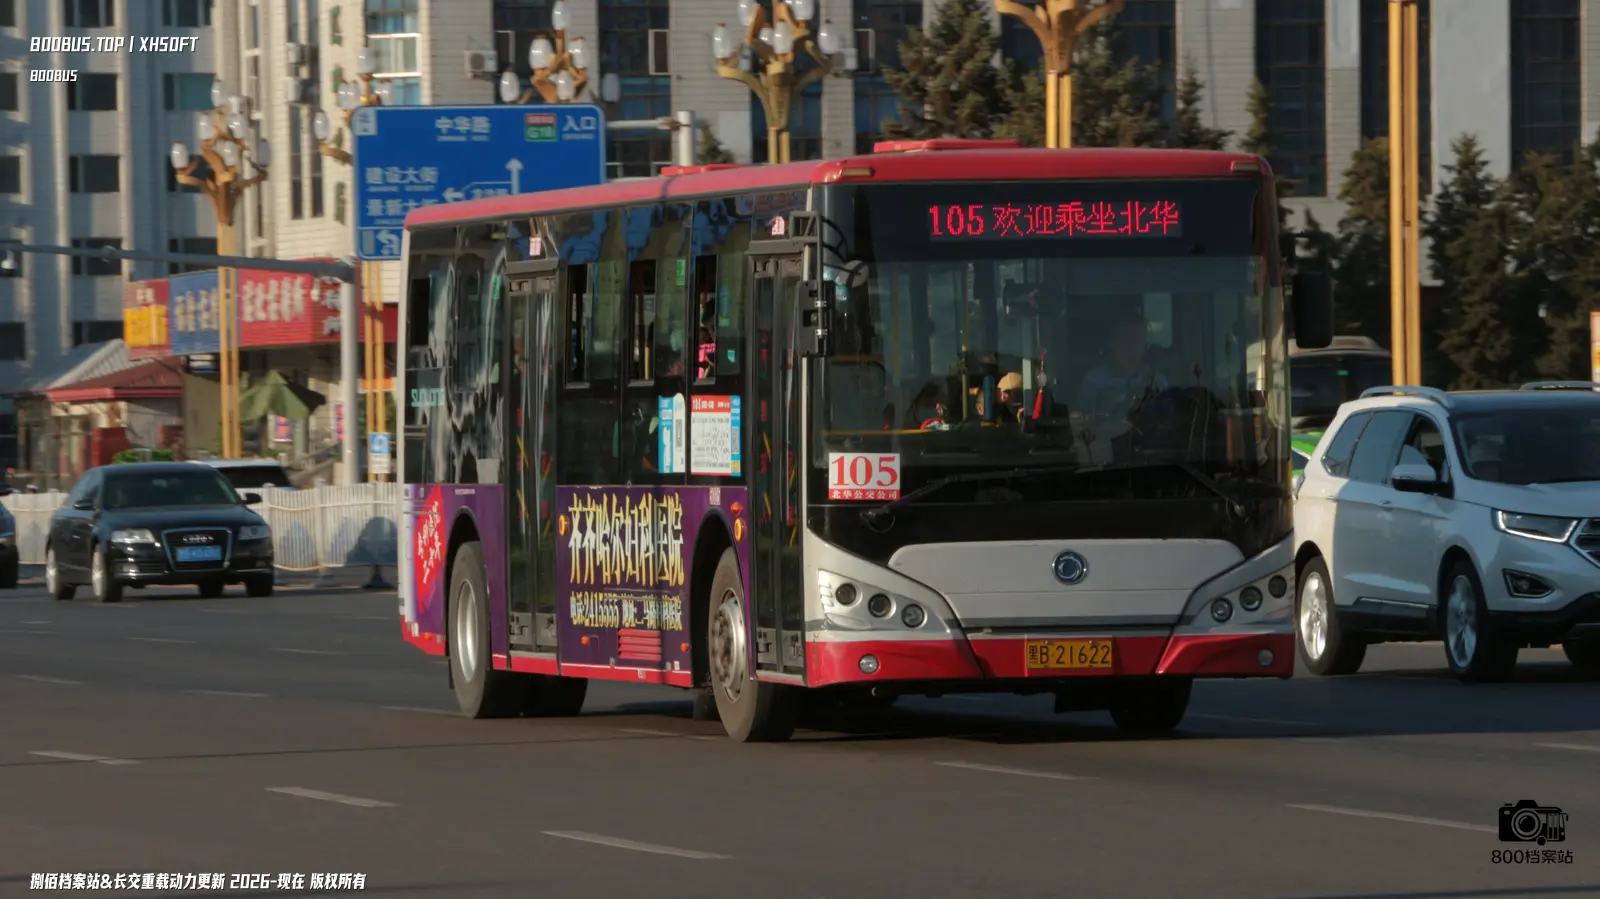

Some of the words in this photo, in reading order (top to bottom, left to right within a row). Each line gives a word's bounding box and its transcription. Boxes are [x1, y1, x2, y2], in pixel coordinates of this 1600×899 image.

[434, 115, 491, 134] 中华路
[562, 115, 597, 132] 入口
[365, 166, 439, 185] 建设大街
[928, 204, 985, 236] 105
[991, 200, 1180, 237] 欢迎乘坐北华
[831, 455, 898, 487] 105
[832, 489, 897, 499] 北华公交公司
[568, 492, 685, 587] 齐齐哈尔妇科医院
